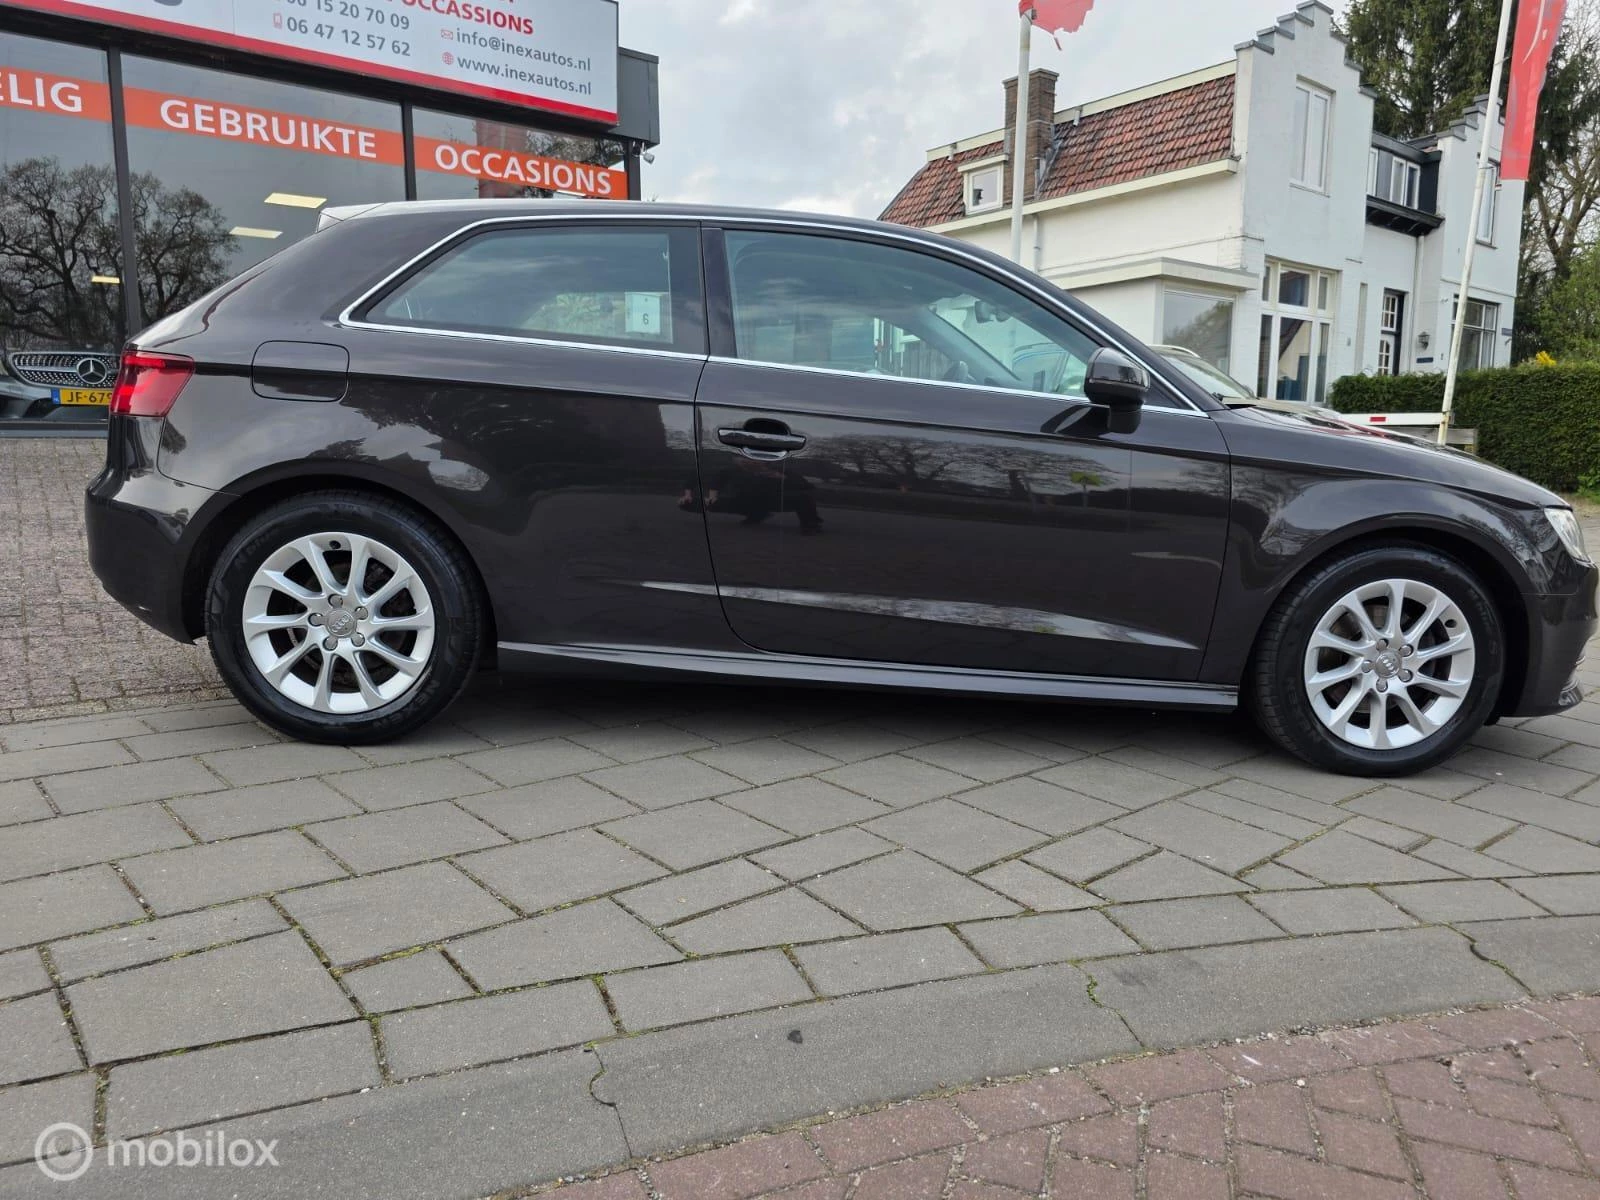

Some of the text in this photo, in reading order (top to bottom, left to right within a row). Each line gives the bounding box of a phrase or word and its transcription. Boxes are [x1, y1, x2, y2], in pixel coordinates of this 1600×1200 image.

[287, 16, 411, 57] 06 47 12 57 62
[339, 1, 359, 18] 20
[365, 7, 385, 24] 70
[390, 13, 410, 30] 09
[456, 28, 591, 71] info@inexautos.nl
[0, 70, 83, 113] LIG
[457, 56, 592, 95] www.inexautos.nl
[160, 98, 377, 159] GEBRUIKTE
[435, 144, 612, 196] OCCASIONS
